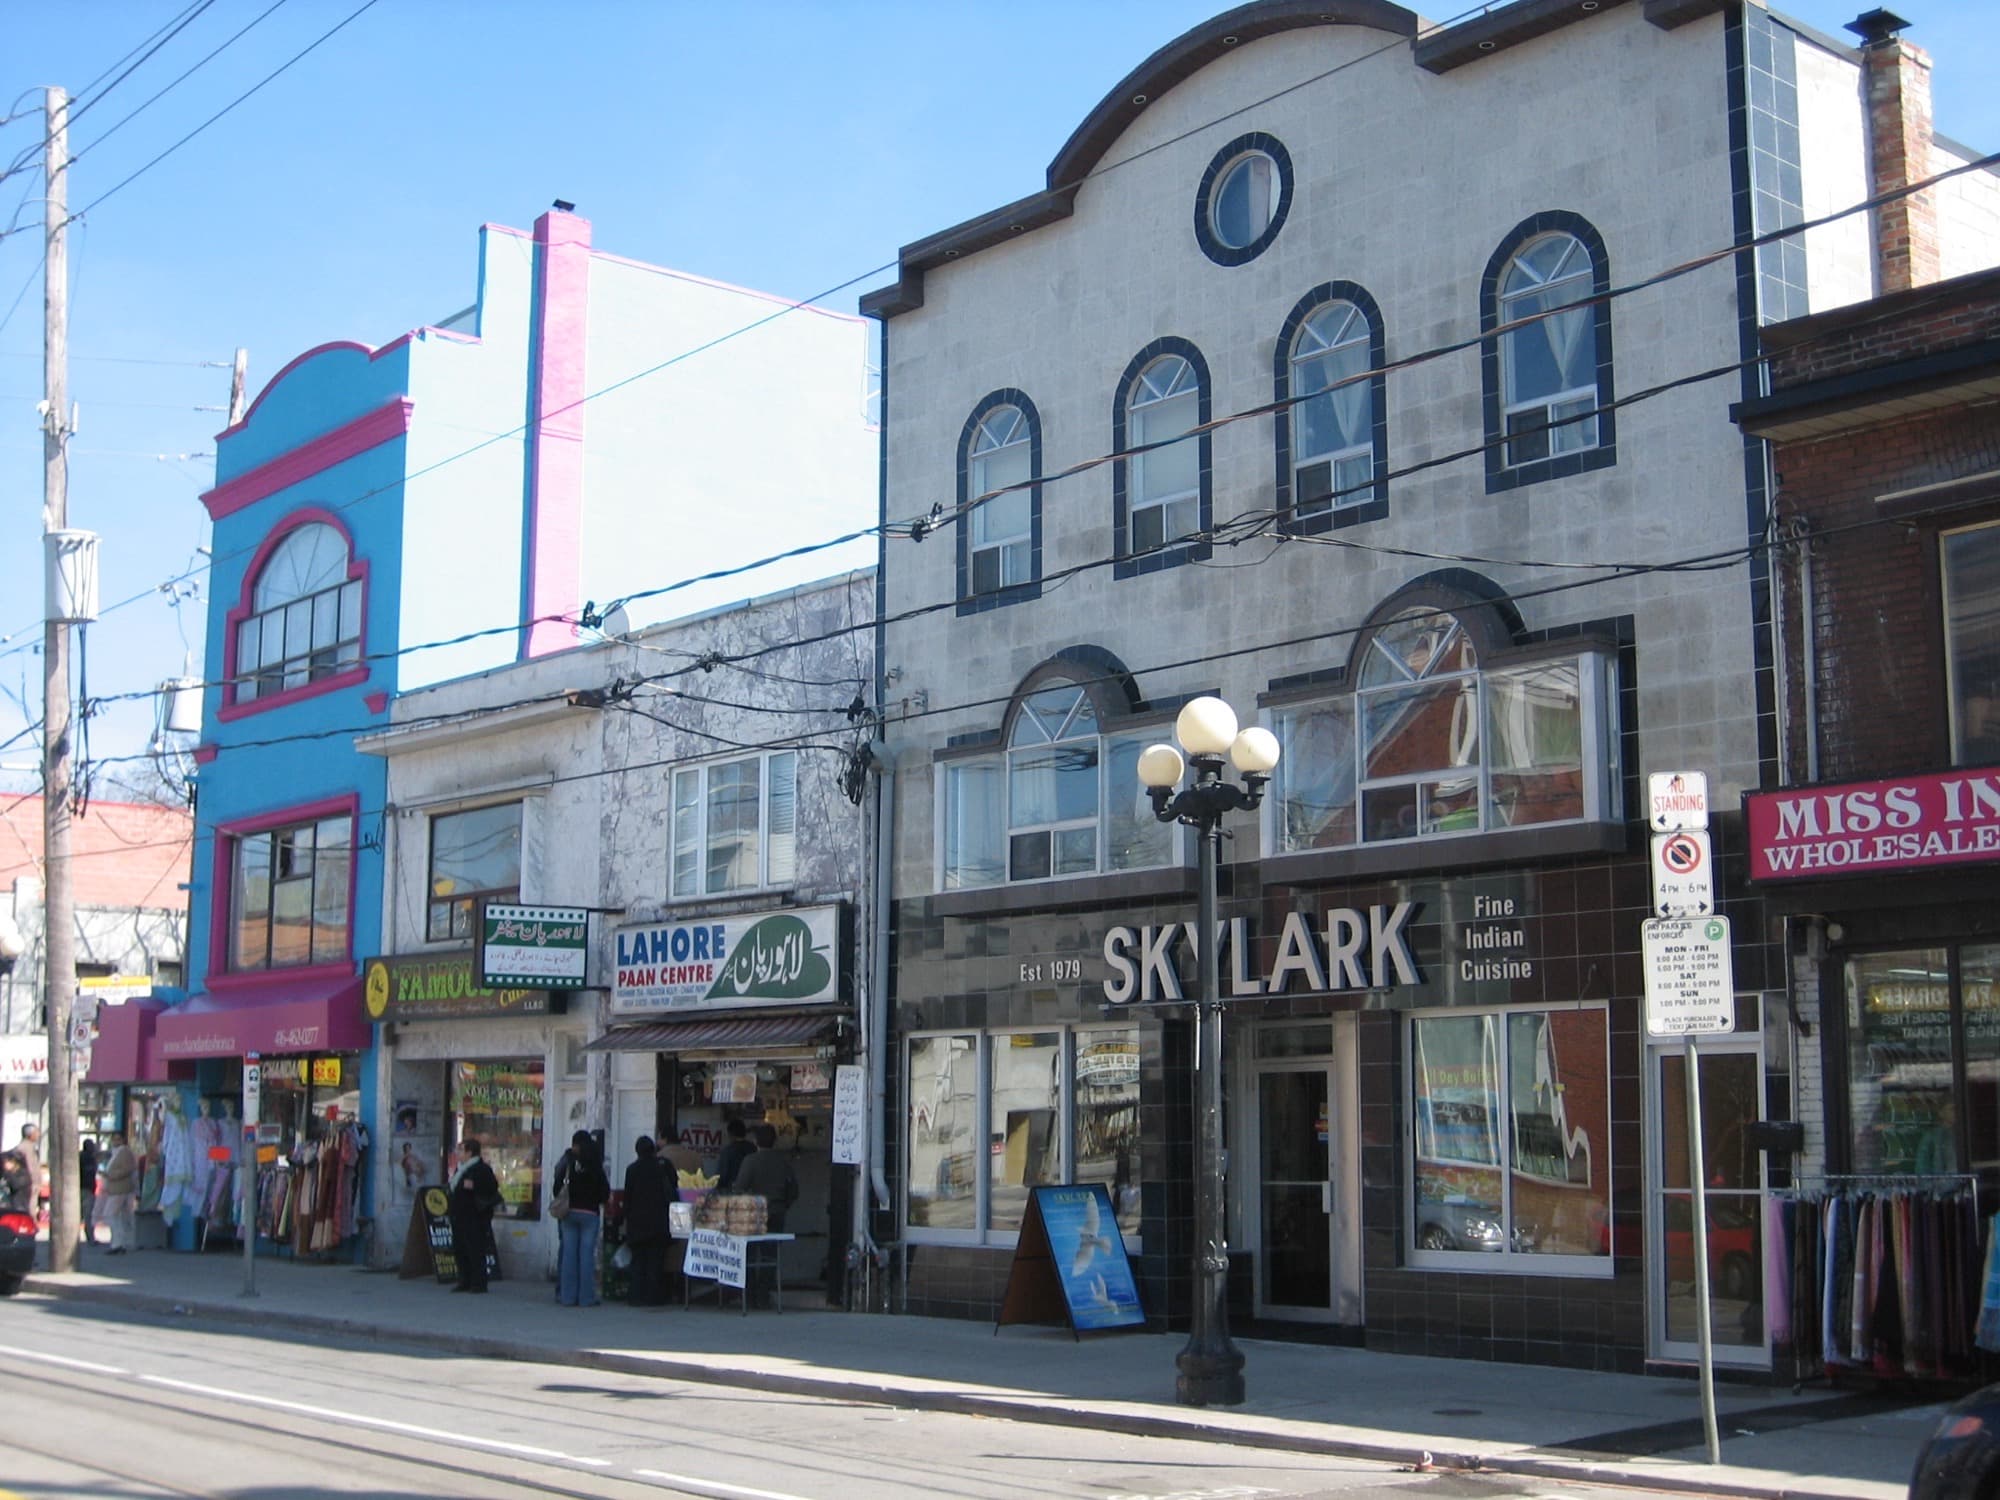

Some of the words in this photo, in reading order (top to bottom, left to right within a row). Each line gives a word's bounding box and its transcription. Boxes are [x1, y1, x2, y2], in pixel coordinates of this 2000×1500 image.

[1654, 794, 1704, 812] STANDING
[1775, 786, 1921, 840] MISS
[1474, 895, 1514, 917] Fine
[617, 925, 725, 966] LAHORE
[1465, 926, 1524, 949] Indian
[1103, 902, 1420, 1004] SKYLARK
[398, 960, 496, 1001] FAMOU
[618, 968, 655, 988] PAAN
[660, 964, 713, 985] CENTRE
[1020, 963, 1042, 982] Est
[1051, 960, 1080, 980] 1979
[1461, 957, 1532, 981] Cuisine
[1440, 1070, 1459, 1086] Day
[680, 1128, 722, 1147] ATM
[720, 1269, 738, 1283] TIME
